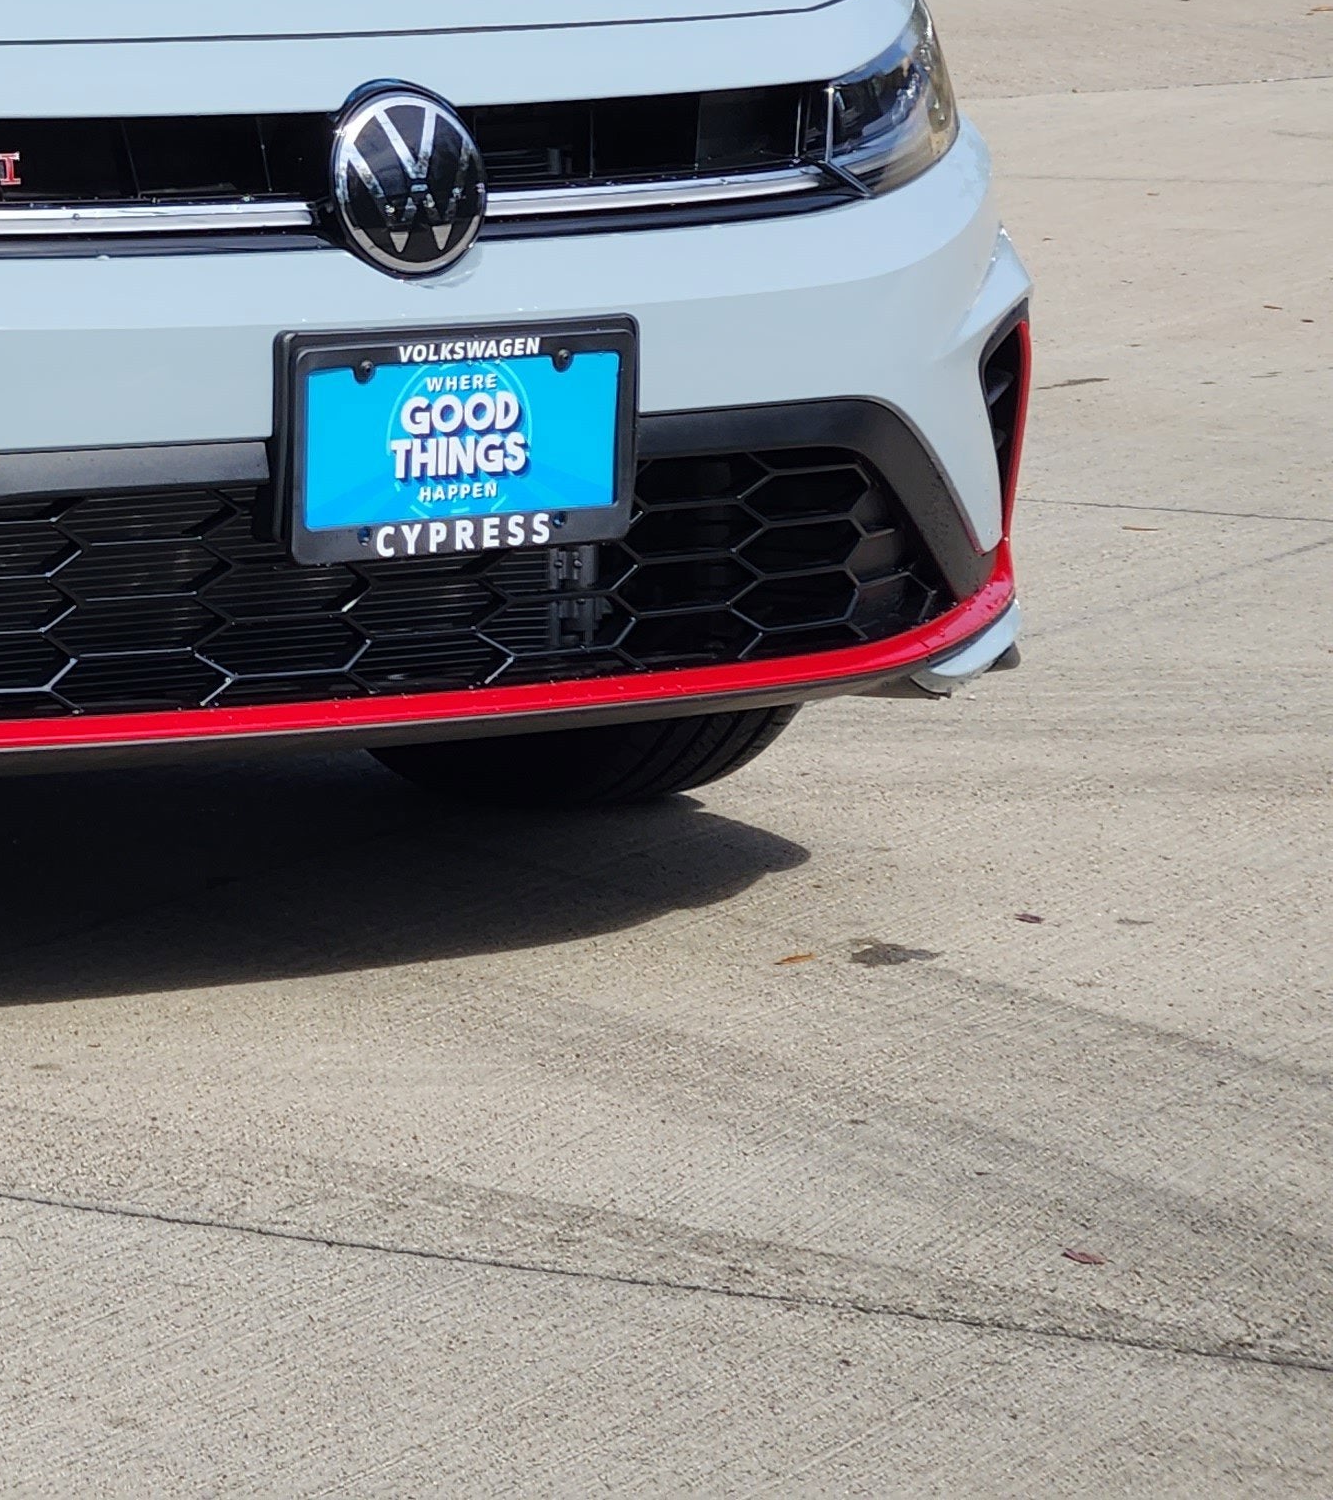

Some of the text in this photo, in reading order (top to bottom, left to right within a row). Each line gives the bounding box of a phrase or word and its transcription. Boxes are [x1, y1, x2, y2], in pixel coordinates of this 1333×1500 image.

[398, 337, 541, 364] VOLKSWAGEN
[426, 373, 498, 393] WHERE
[400, 391, 521, 435] GOOD
[390, 431, 527, 480] THINGS
[418, 481, 498, 503] HAPPEN
[376, 512, 551, 559] CYPRESS
